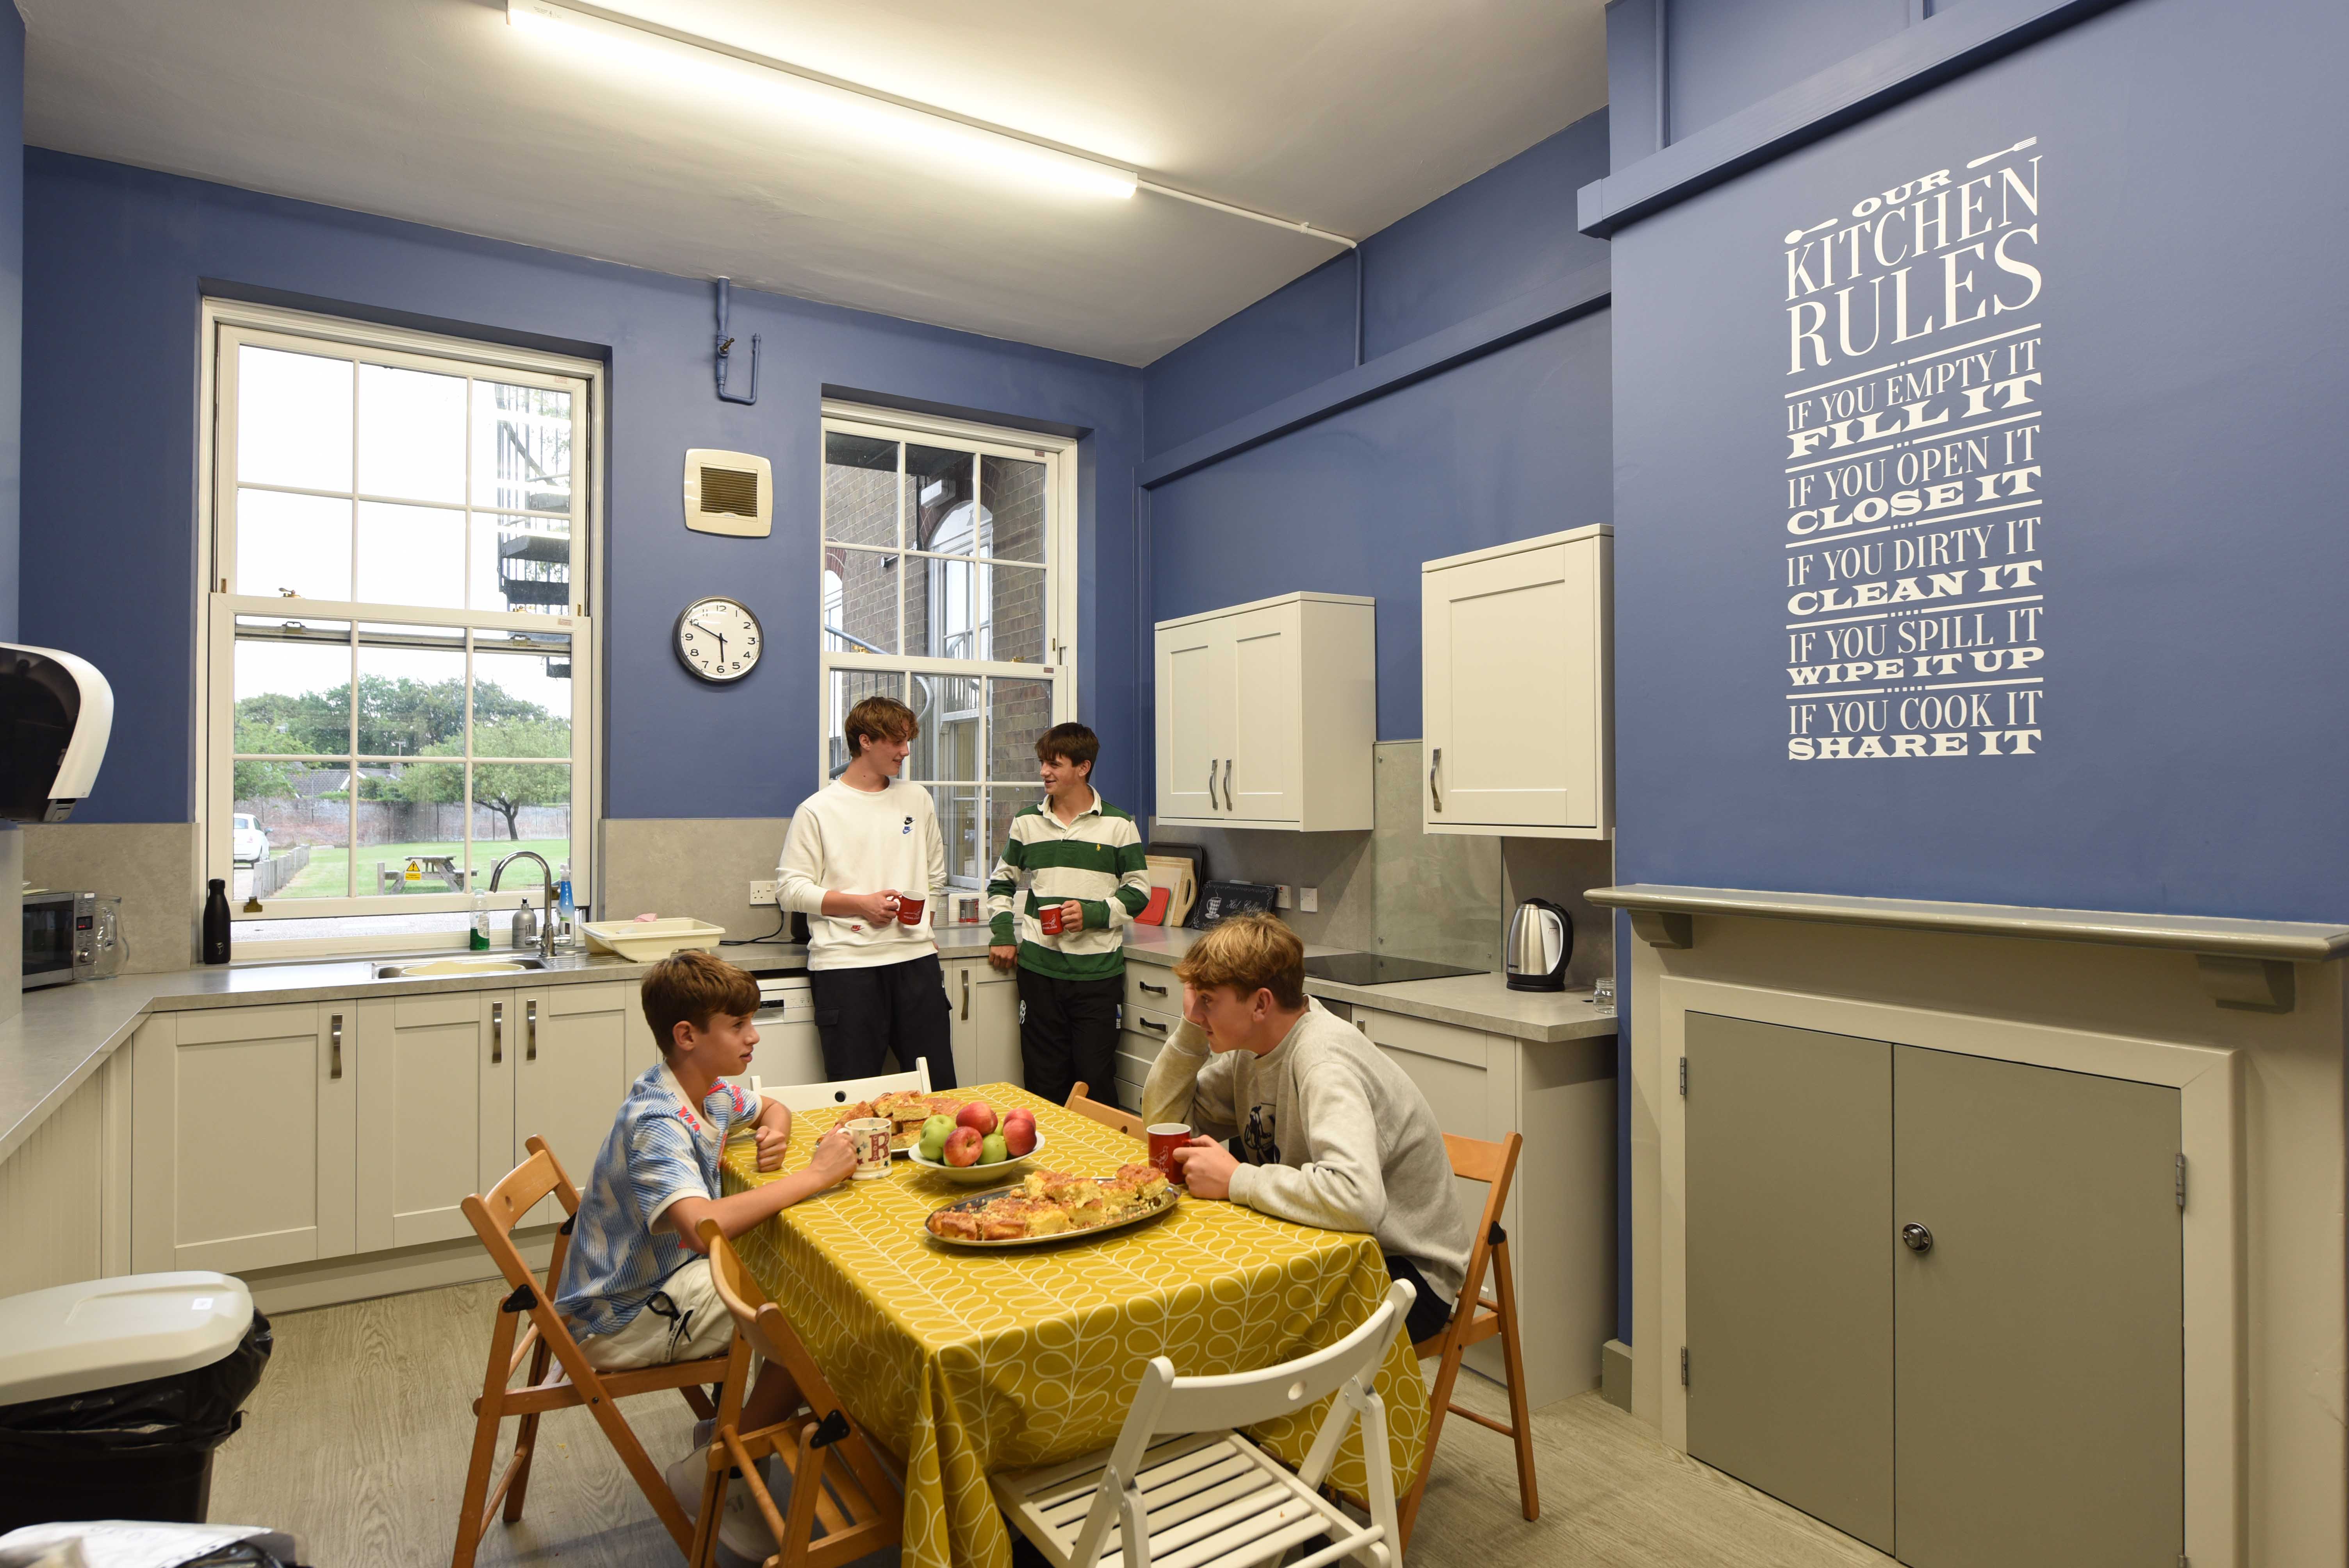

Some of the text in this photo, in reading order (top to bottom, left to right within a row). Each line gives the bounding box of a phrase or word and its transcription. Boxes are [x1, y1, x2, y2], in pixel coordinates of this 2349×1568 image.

[1852, 169, 1953, 217] OUR
[1784, 155, 2043, 301] KITCHEN
[1786, 223, 2042, 375] RULES
[1787, 338, 2041, 432] IF YOU EMPTY IT
[1786, 372, 2042, 460] FILL IT
[1788, 425, 2040, 509] IF YOU OPEN IT
[1787, 465, 2041, 535] CLOSE IT
[1787, 517, 2041, 587] IF YOU DIRTY IT
[1788, 559, 2042, 615] CLEAN IT
[690, 649, 699, 657] 8
[1789, 607, 2043, 663] IF YOU SPILL IT
[702, 661, 709, 669] 7
[716, 665, 725, 674] 6
[1786, 647, 2044, 686] WIPE IT UP
[1789, 690, 2042, 734] IF YOU COOK IT
[1788, 729, 2041, 760] SHARE IT
[1226, 899, 1262, 916] Hot Coffee
[868, 1131, 889, 1162] R
